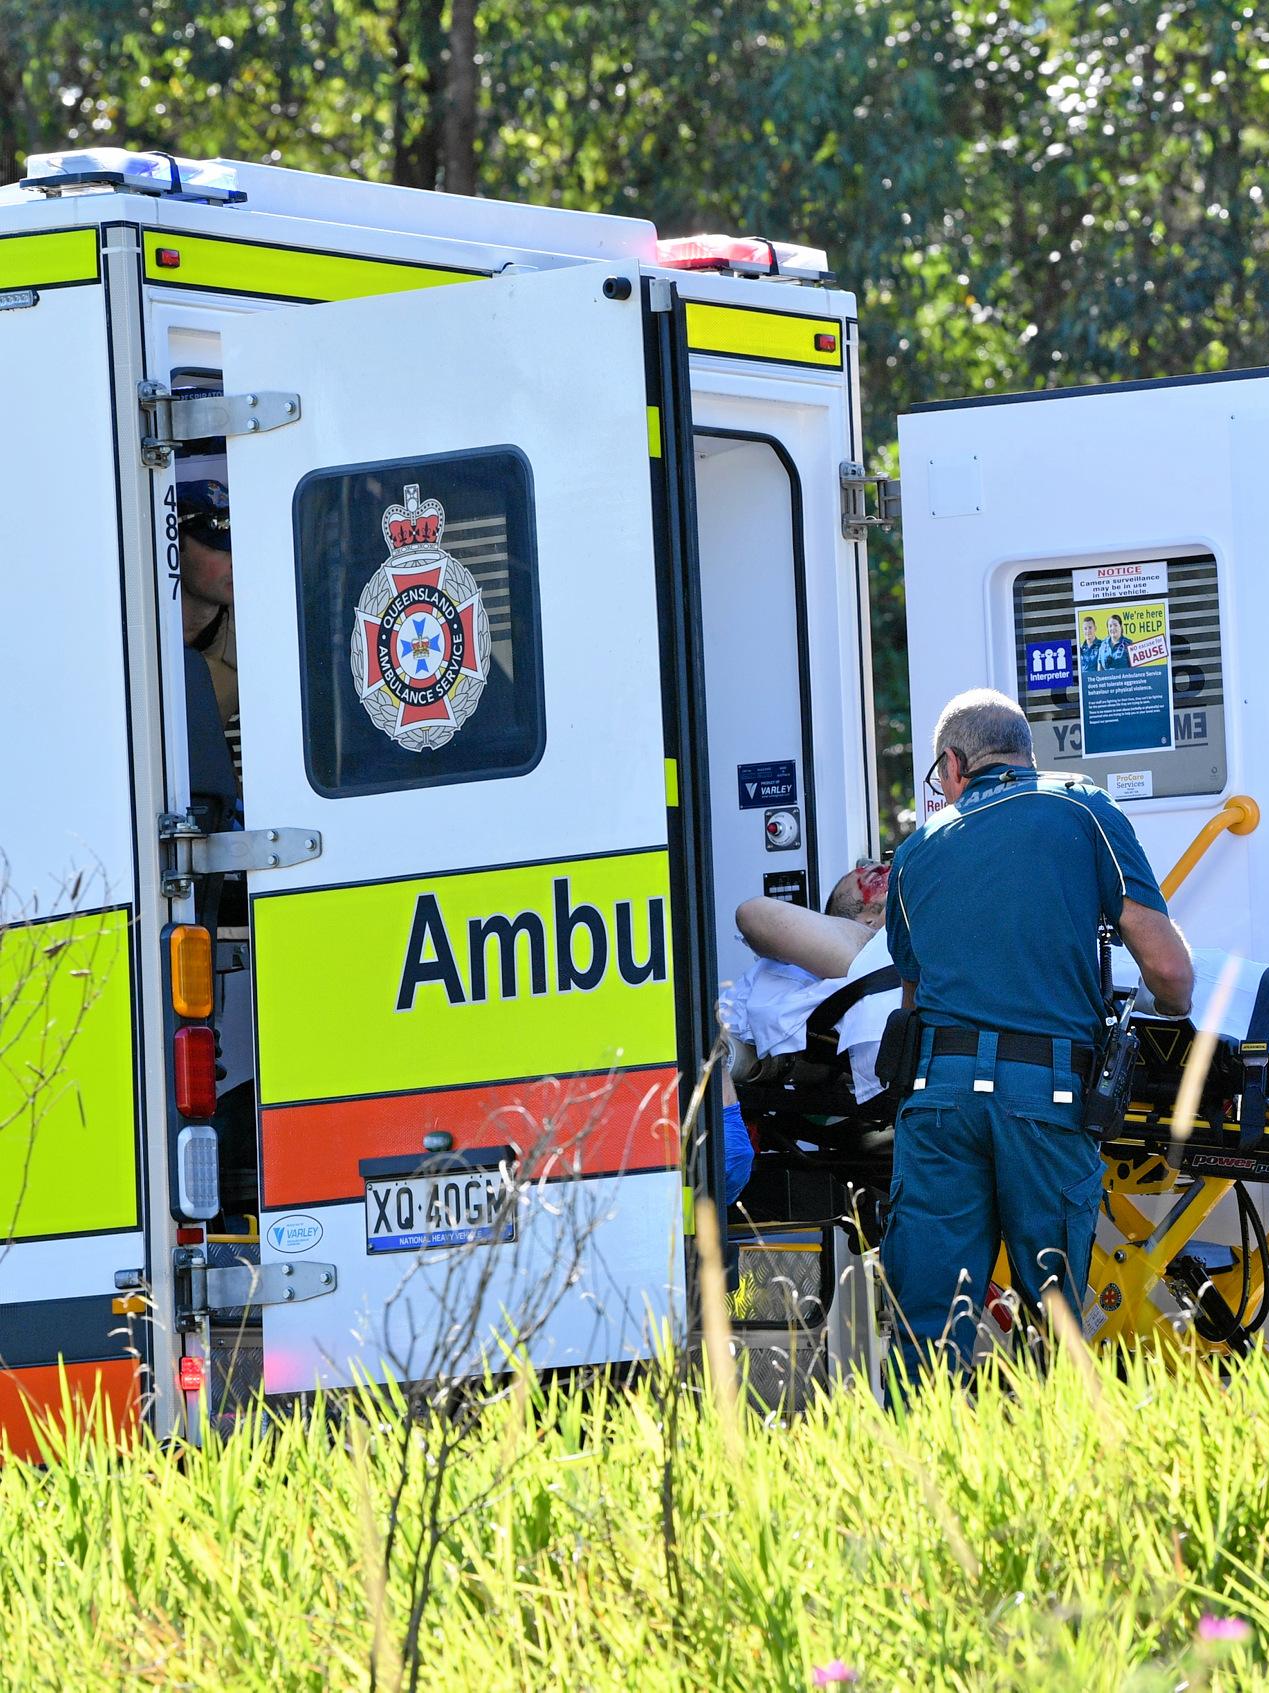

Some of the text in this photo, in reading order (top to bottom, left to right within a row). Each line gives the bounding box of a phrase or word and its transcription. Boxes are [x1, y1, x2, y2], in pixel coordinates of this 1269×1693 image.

[164, 485, 181, 600] 4807
[1097, 566, 1142, 577] NOTICE
[1080, 575, 1160, 587] Camera surveillance
[1101, 590, 1116, 598] this
[1118, 588, 1149, 596] vehicle.
[383, 588, 455, 629] QUEENSLAND
[1122, 609, 1163, 620] We're here
[1124, 620, 1163, 634] TO HELP
[1132, 645, 1165, 663] ABUSE
[379, 633, 463, 705] AMBULANCE SERVICE
[1030, 671, 1070, 682] Interpreter
[761, 784, 792, 795] VARLEY
[1116, 781, 1145, 789] Services
[394, 877, 667, 1012] Ambu
[286, 1226, 319, 1239] VARLEY
